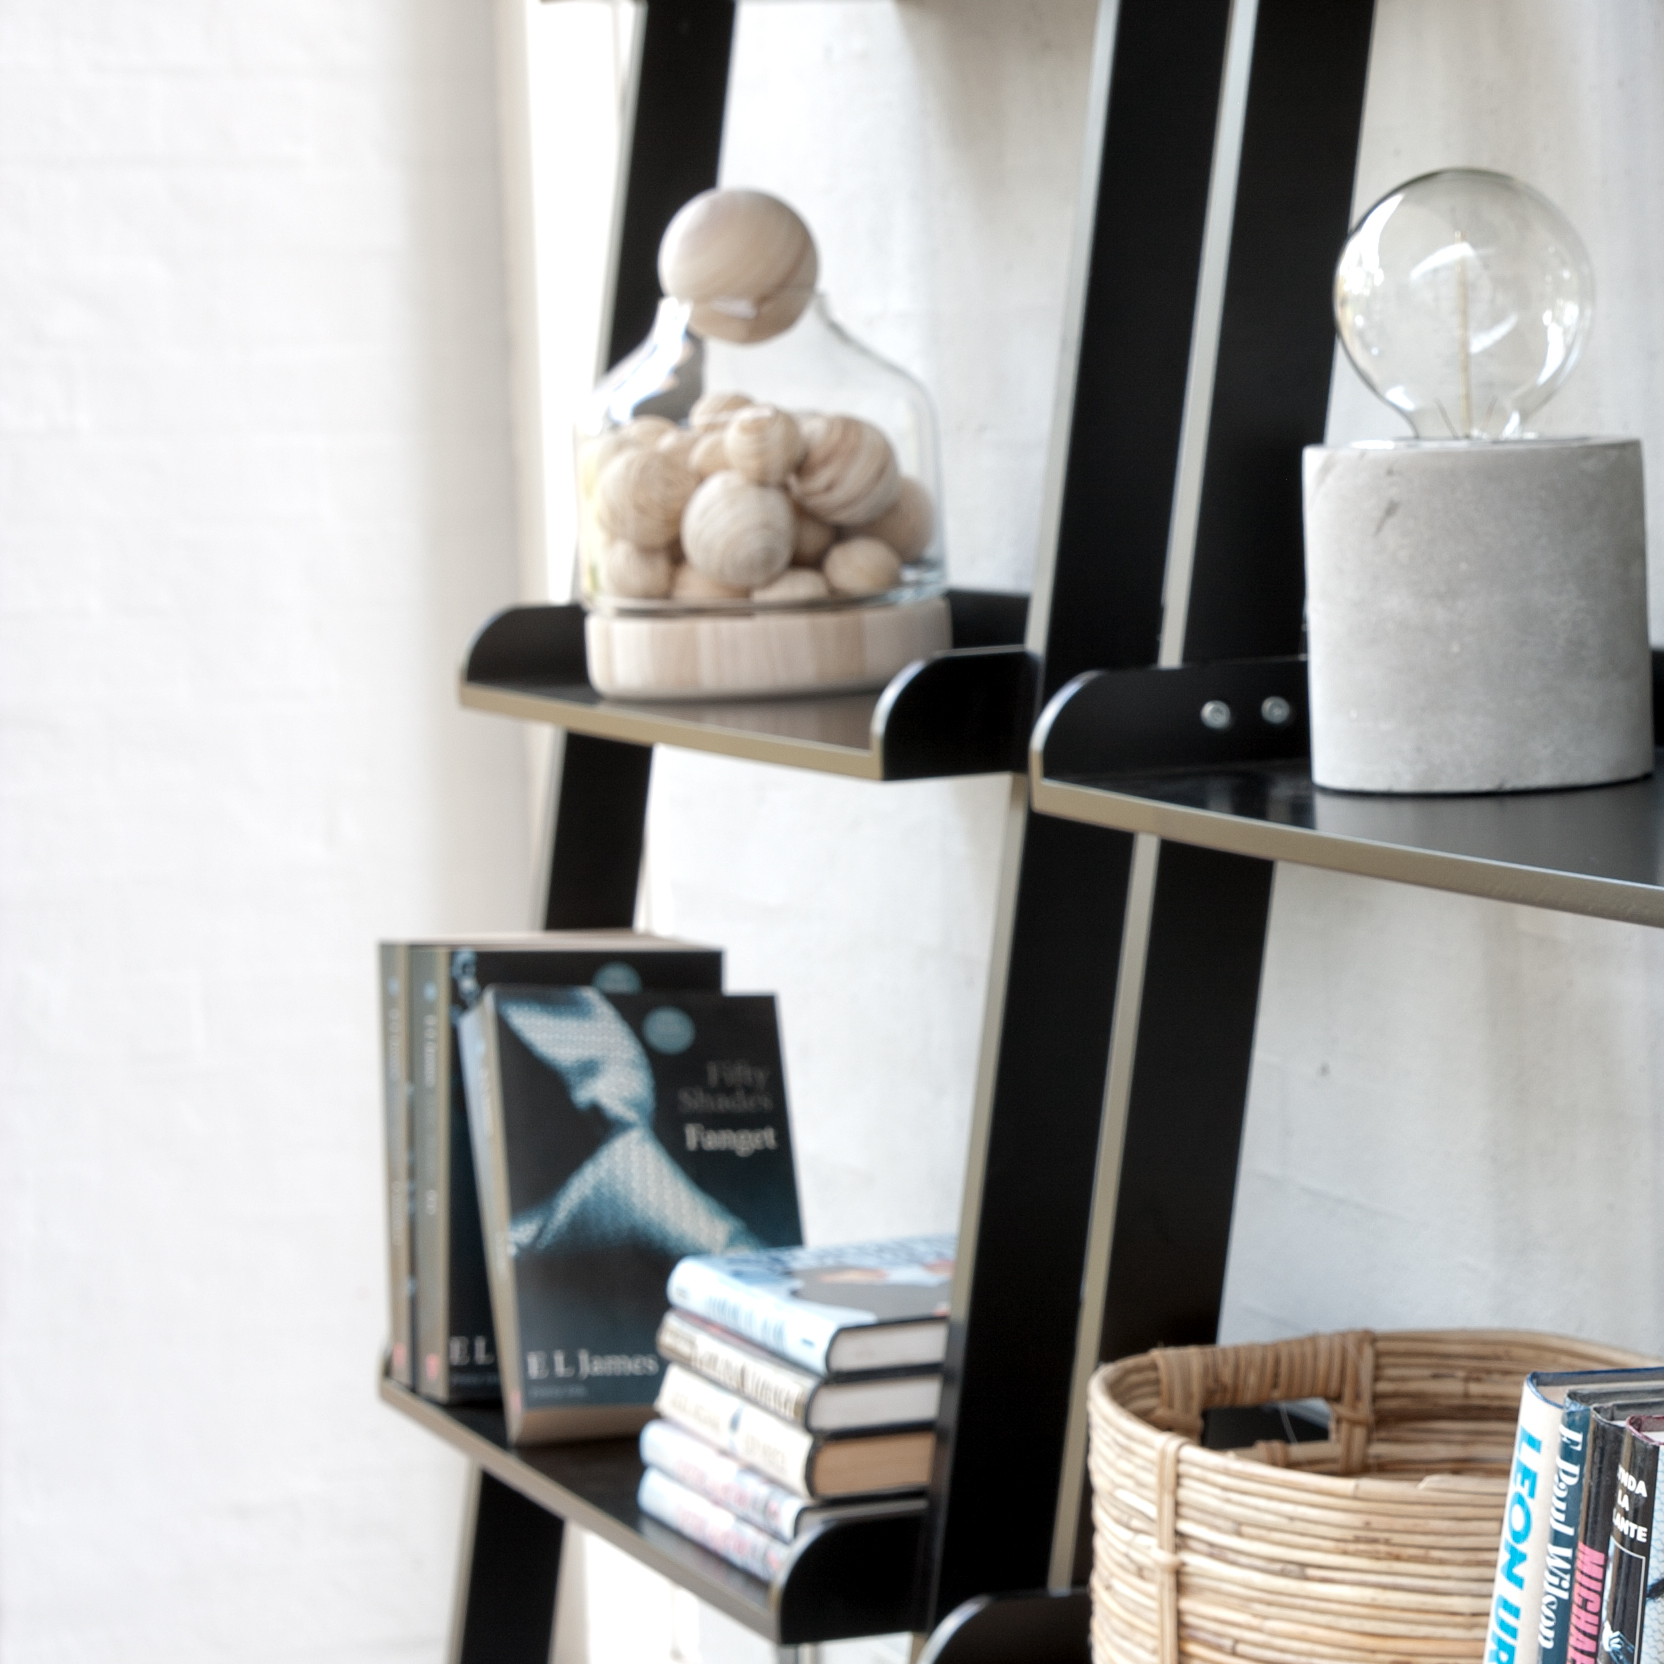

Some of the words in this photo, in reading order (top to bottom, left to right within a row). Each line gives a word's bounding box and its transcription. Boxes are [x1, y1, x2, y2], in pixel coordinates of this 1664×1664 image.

[685, 1123, 777, 1158] Fanget
[527, 1350, 548, 1380] E
[554, 1348, 575, 1378] L
[578, 1347, 660, 1380] James
[1500, 1424, 1543, 1591] LEON
[1549, 1455, 1581, 1538] Paul
[1538, 1541, 1575, 1650] Wilson
